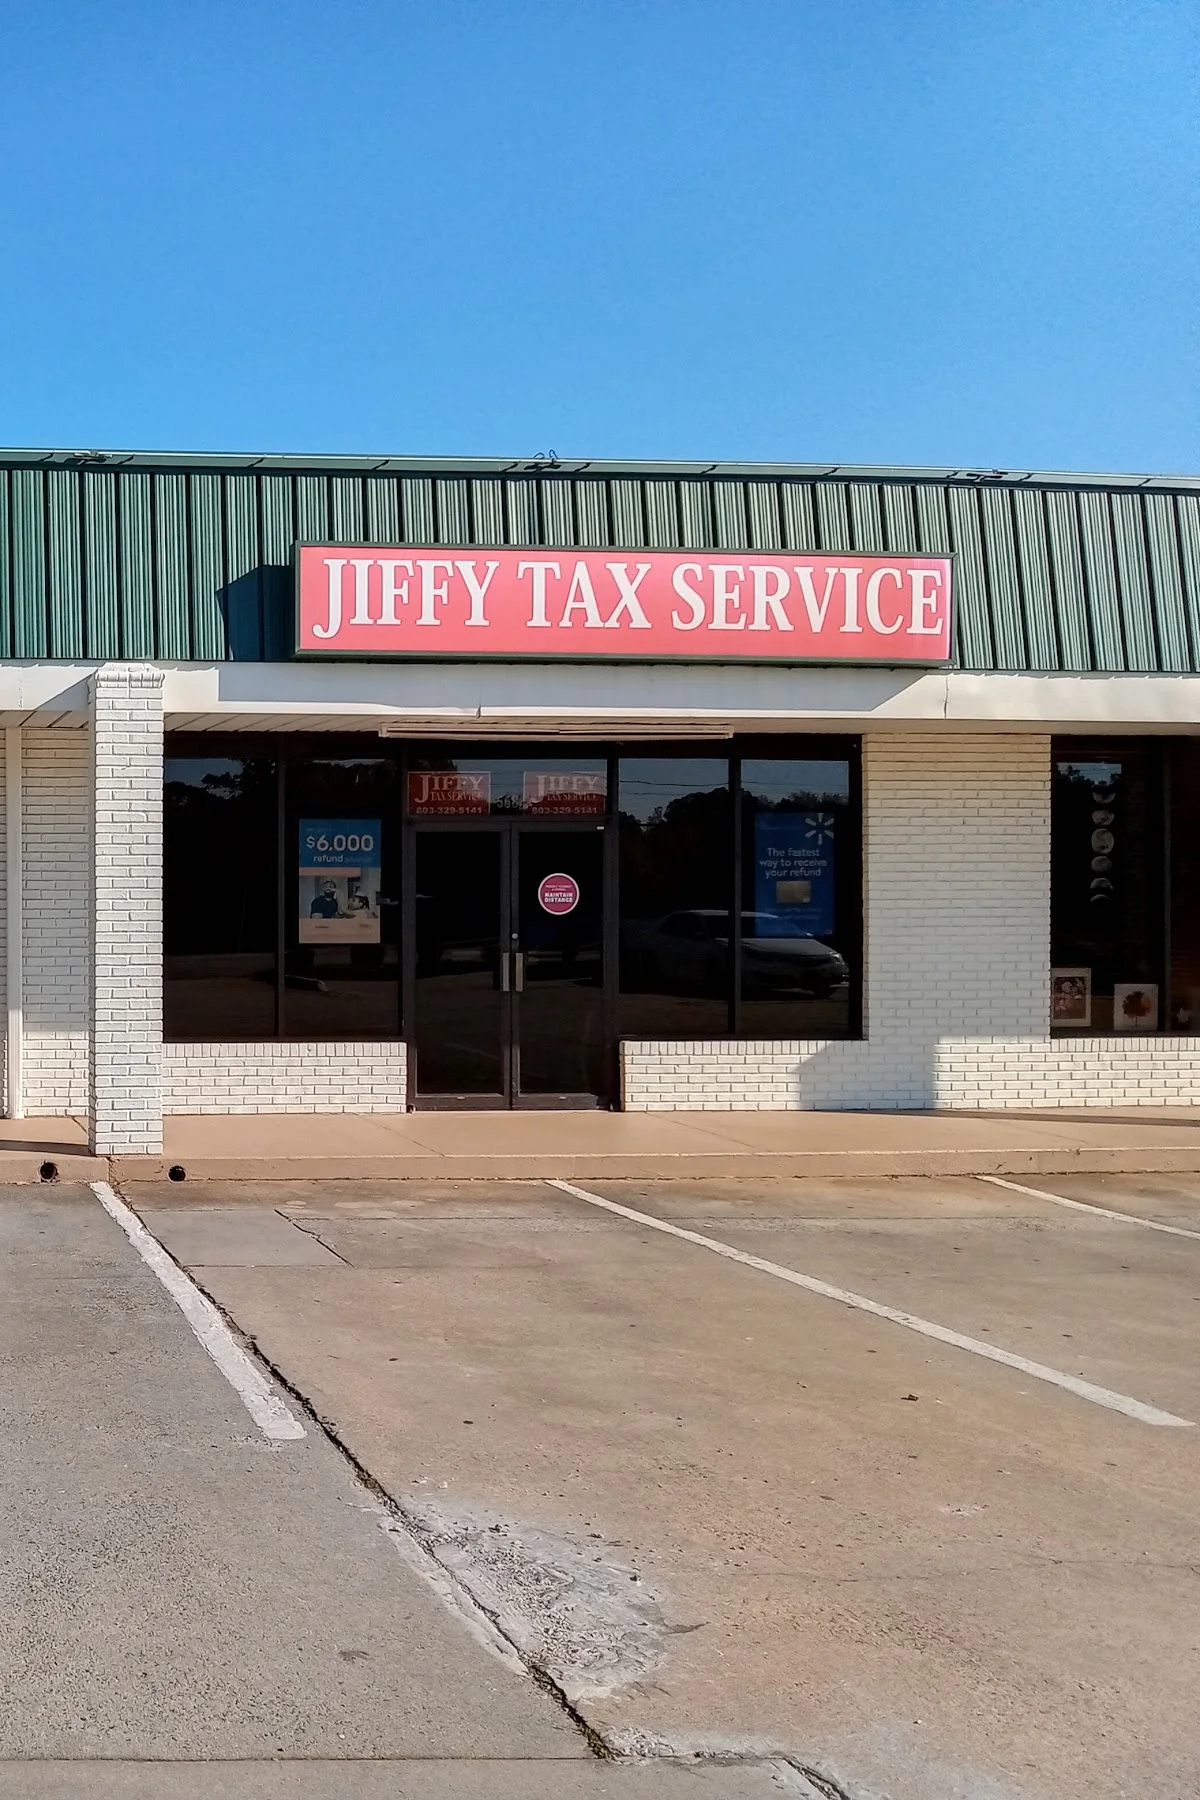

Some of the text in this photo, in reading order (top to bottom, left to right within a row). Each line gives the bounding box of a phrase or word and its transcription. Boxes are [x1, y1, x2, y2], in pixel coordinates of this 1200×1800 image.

[312, 558, 944, 639] JIFFY TAX SERVICE
[414, 774, 484, 804] JIFFY
[530, 774, 598, 804] JIFFY
[430, 791, 483, 802] TAX SERVICE
[547, 792, 598, 802] TAX SERVICE
[415, 806, 483, 815] 803-329-5141
[531, 806, 598, 815] 803-329-5141
[306, 834, 374, 852] $6,000
[766, 847, 821, 857] The fastest
[313, 854, 344, 863] refund
[760, 858, 828, 869] way to receive
[765, 868, 821, 879] your refund
